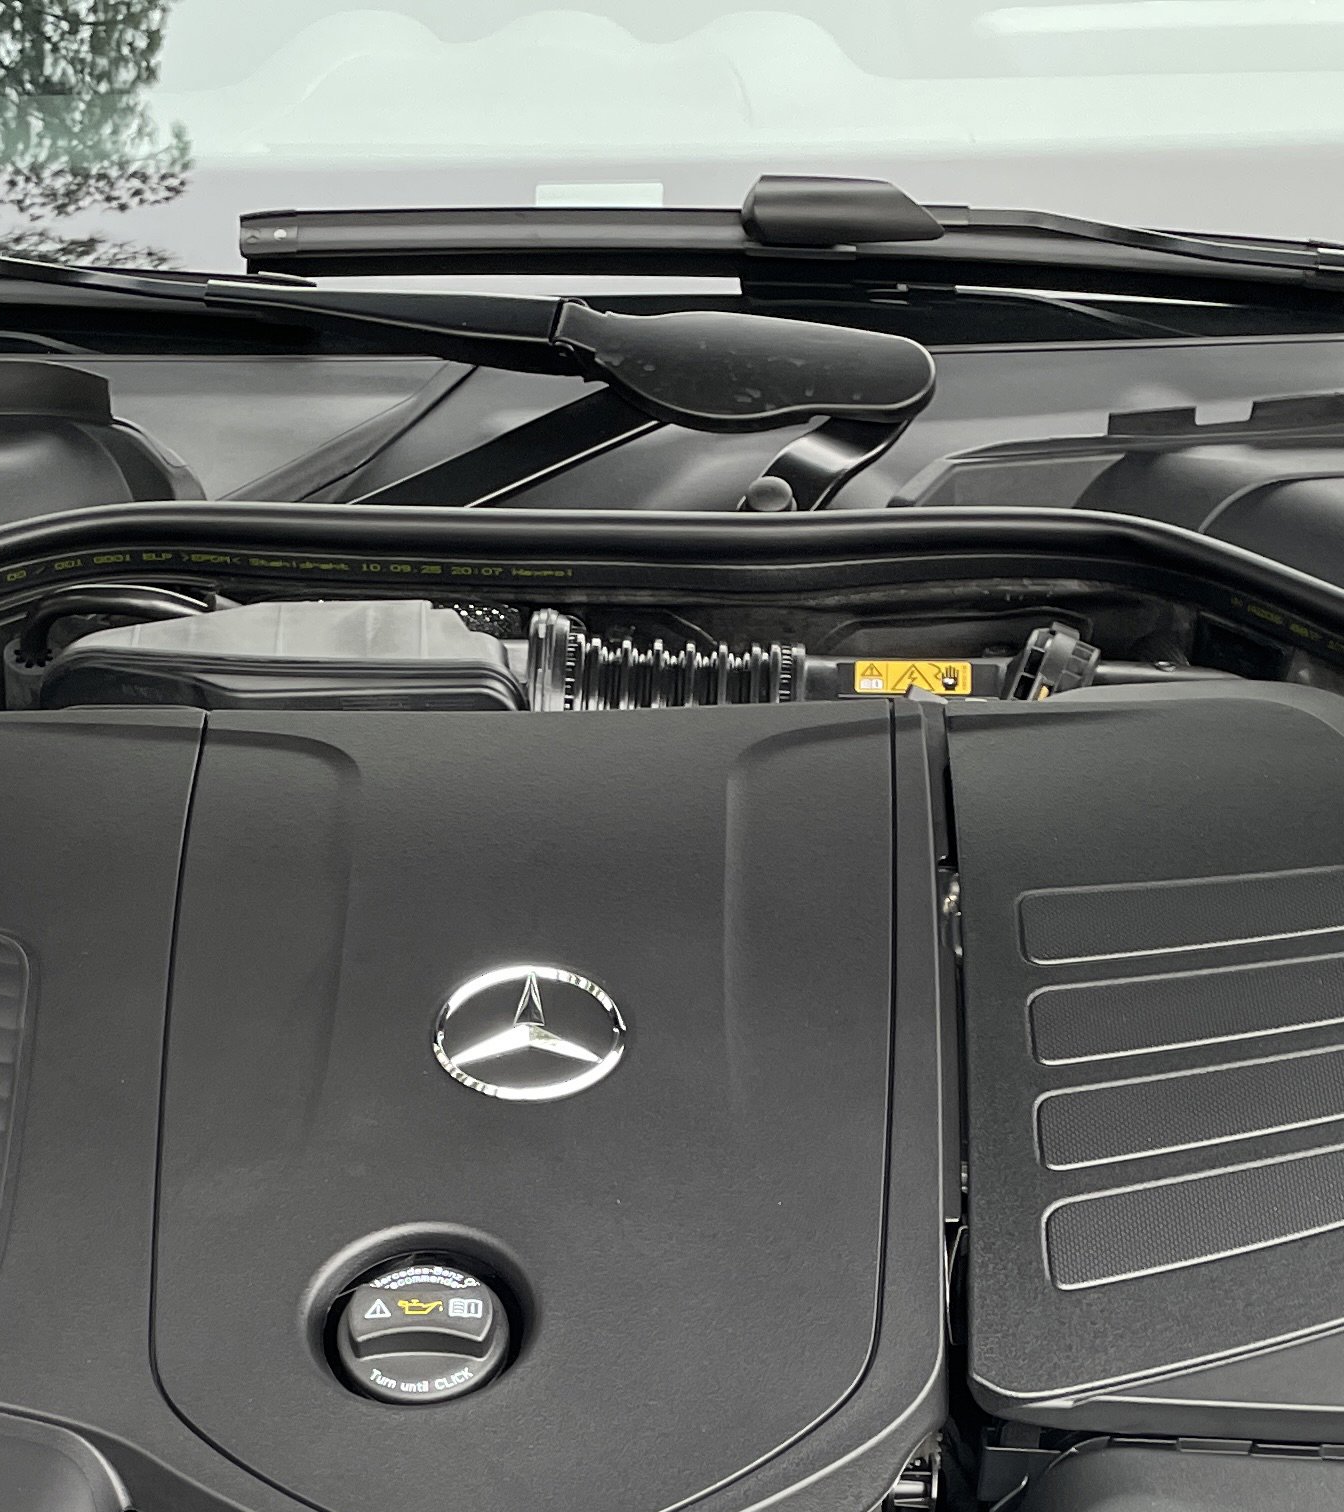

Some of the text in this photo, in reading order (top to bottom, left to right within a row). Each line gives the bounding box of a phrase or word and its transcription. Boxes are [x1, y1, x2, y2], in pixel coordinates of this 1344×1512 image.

[369, 1367, 474, 1393] Turn until CLICK
